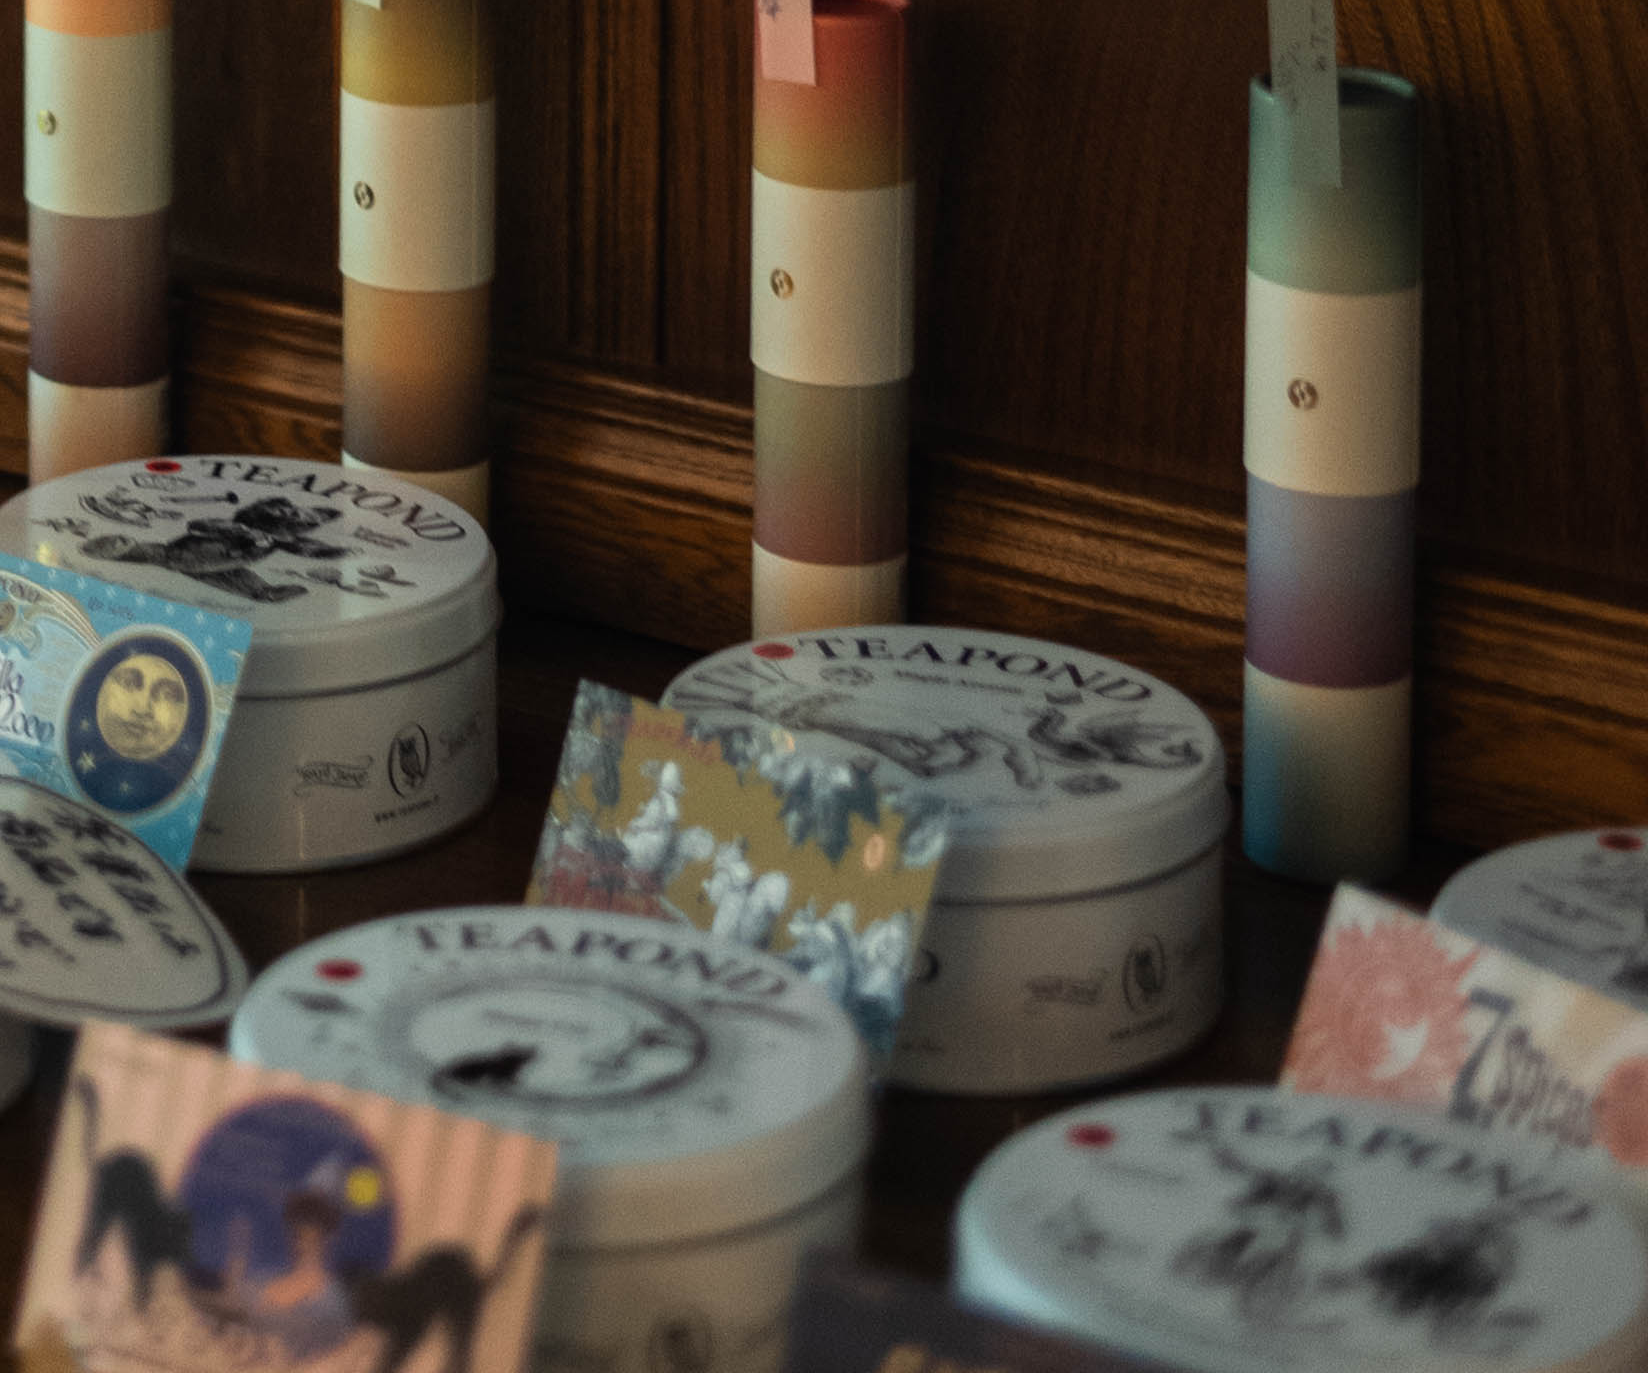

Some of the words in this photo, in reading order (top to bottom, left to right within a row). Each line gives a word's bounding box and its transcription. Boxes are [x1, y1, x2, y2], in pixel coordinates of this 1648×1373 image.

[199, 458, 467, 542] TEAPOND
[798, 636, 1152, 702] TEAPOND
[402, 921, 789, 997] TEAPOND
